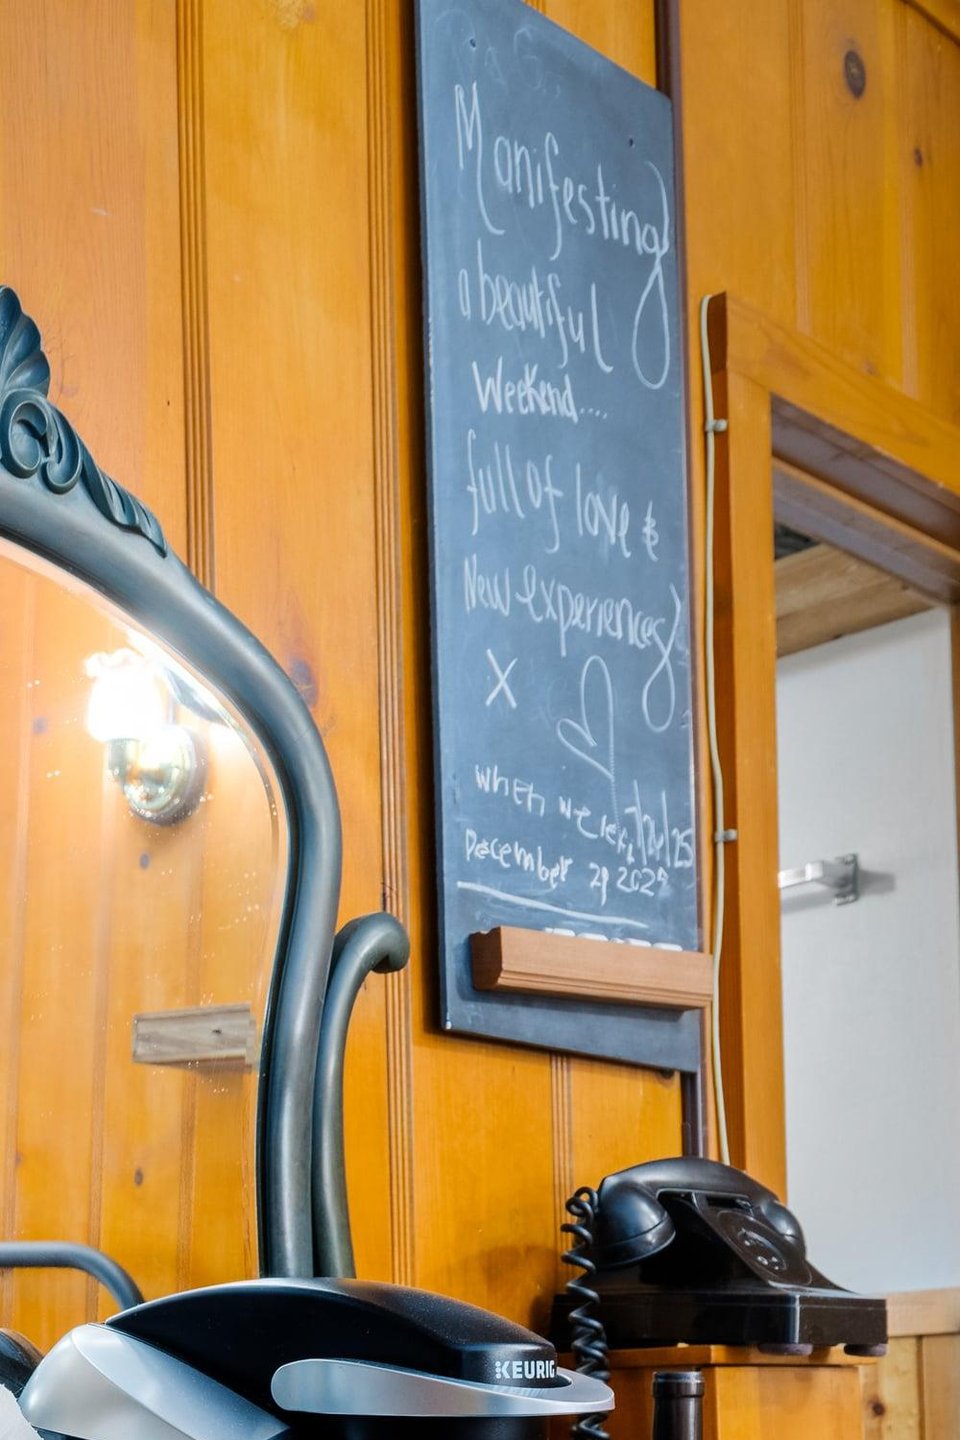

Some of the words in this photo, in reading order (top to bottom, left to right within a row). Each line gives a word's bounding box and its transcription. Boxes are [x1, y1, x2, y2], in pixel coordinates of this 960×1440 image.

[454, 80, 671, 389] Manifesting
[477, 238, 614, 374] beautiful
[466, 428, 526, 536] full
[526, 454, 564, 554] of
[575, 462, 632, 558] love
[465, 827, 574, 890] December
[495, 1360, 556, 1379] KEURIG
